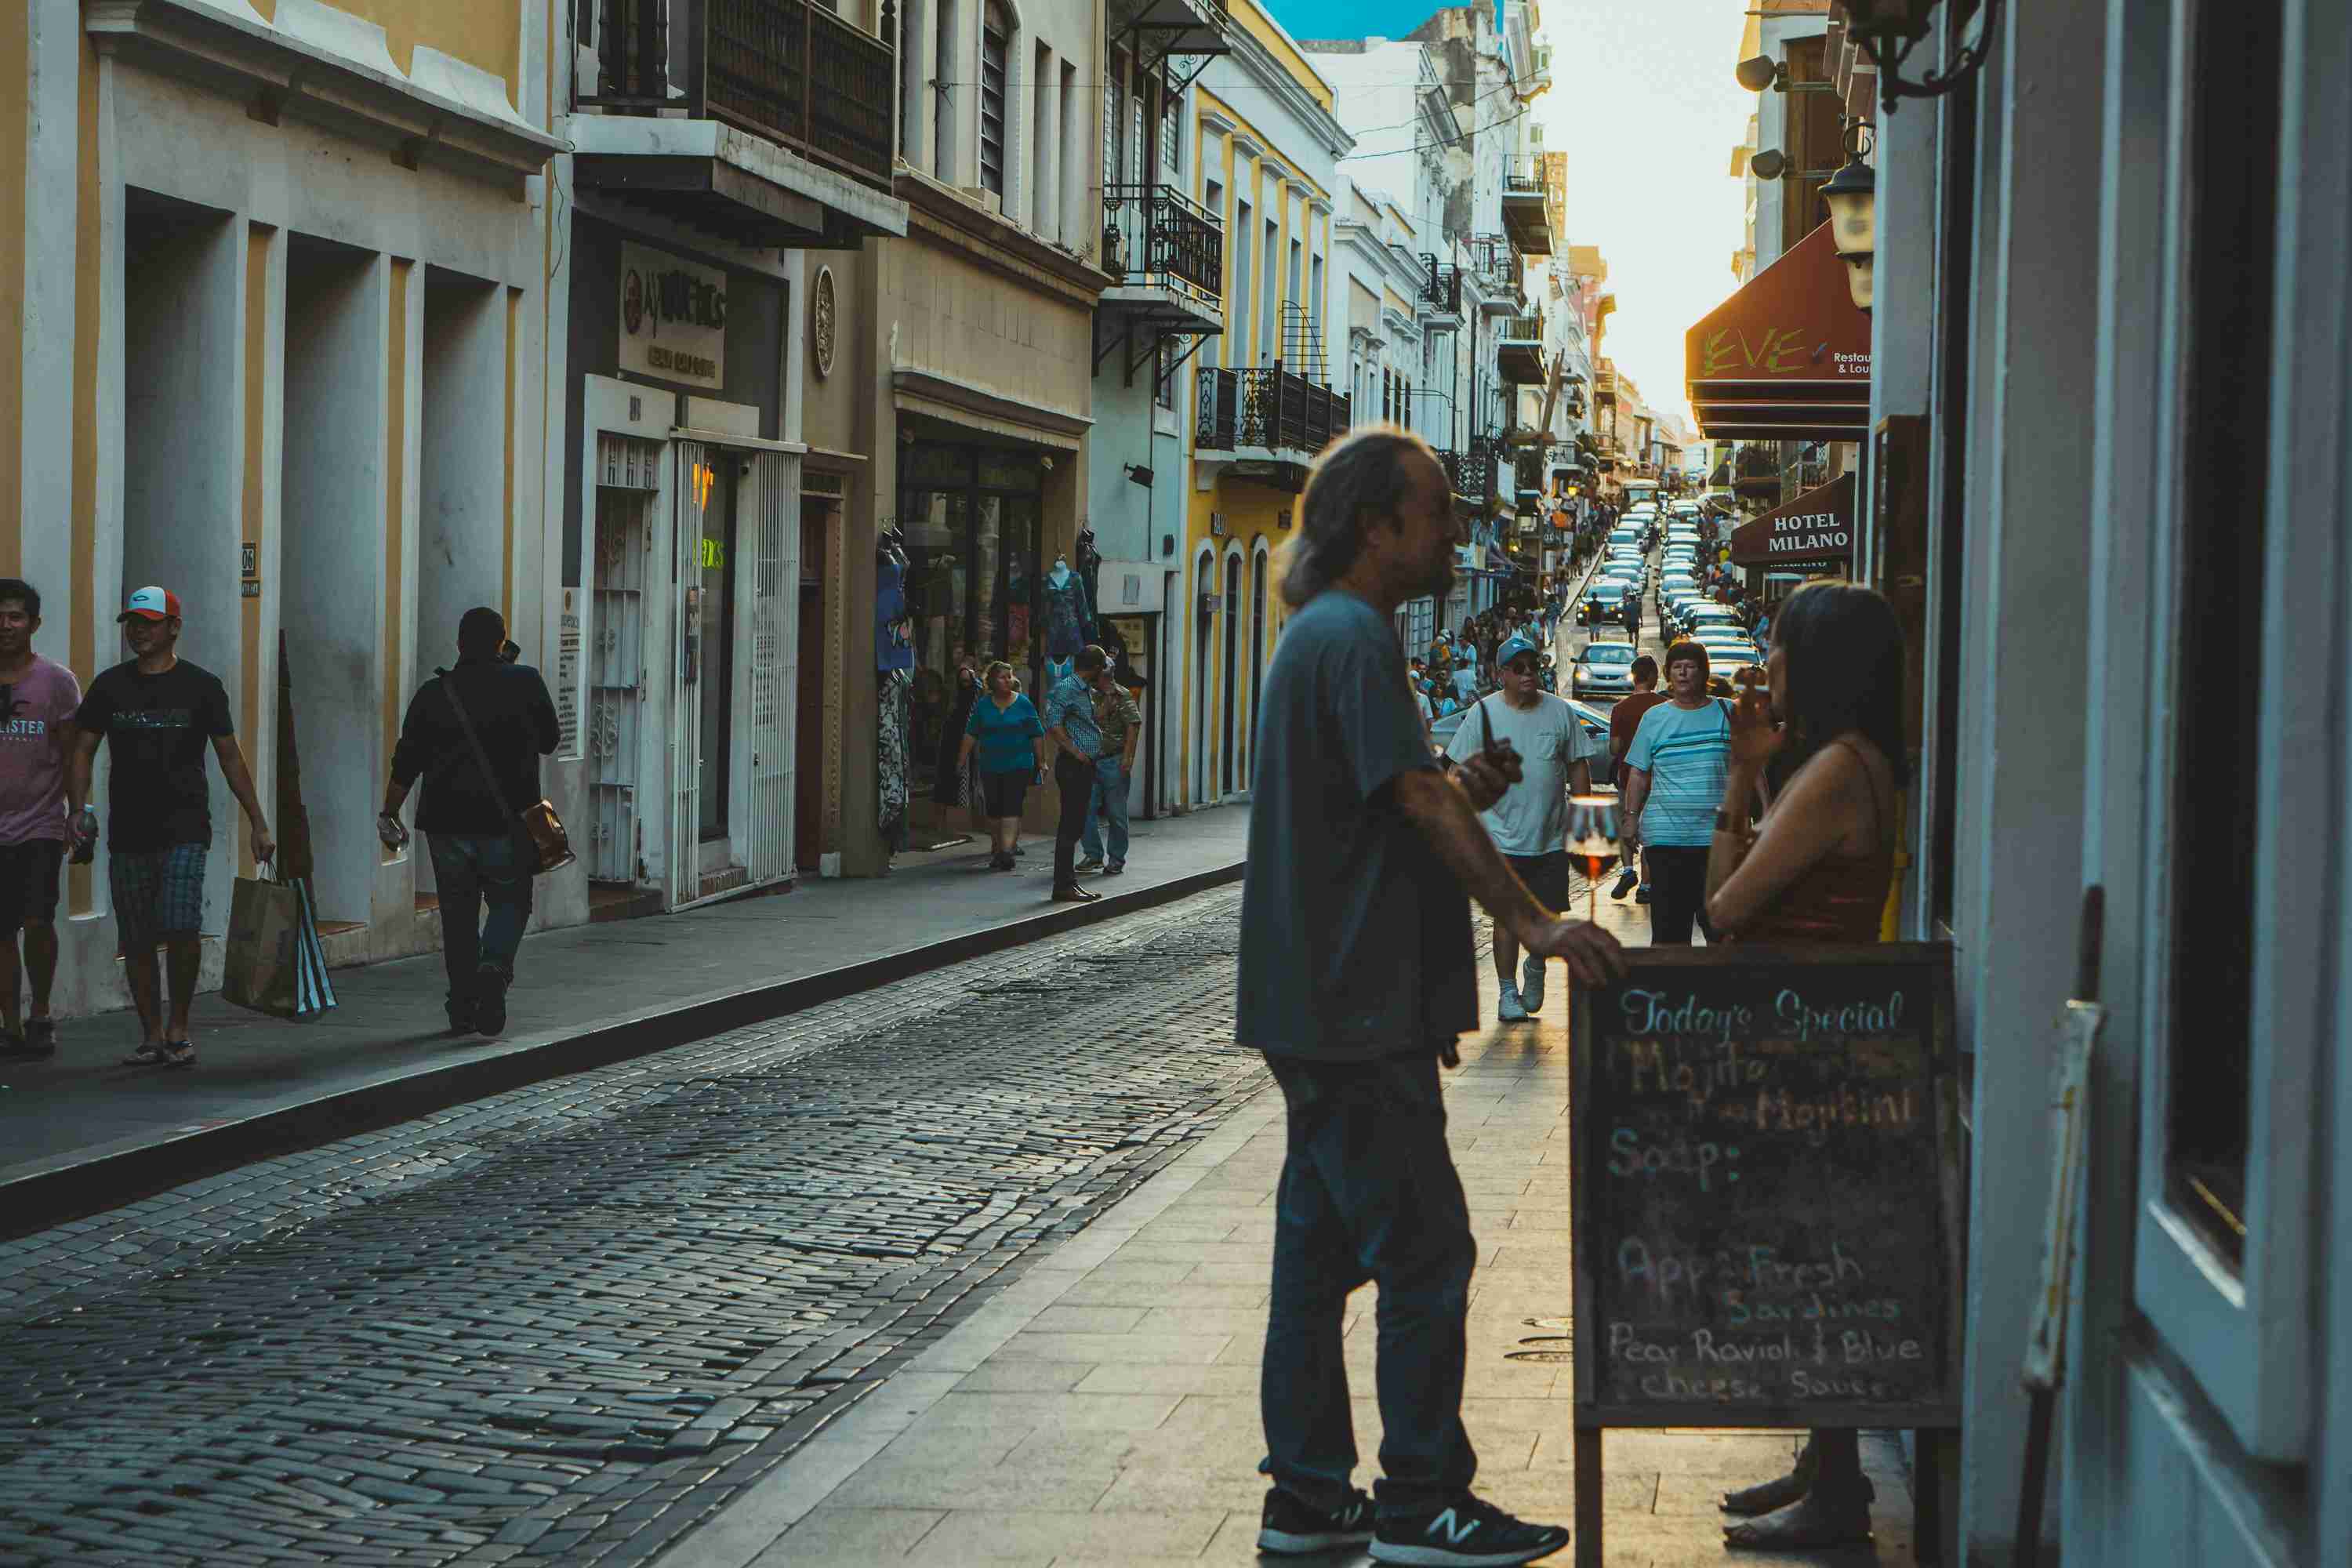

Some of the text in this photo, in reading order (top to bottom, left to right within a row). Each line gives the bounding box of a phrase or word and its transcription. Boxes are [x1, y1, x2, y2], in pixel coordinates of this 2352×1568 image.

[1704, 328, 1806, 376] EVE
[1838, 365, 1846, 374] &
[1775, 513, 1841, 532] HOTEL
[1769, 532, 1849, 553] MILANO
[1619, 987, 1906, 1047] Today's Special
[1609, 1322, 1678, 1362] Pear
[1841, 1330, 1922, 1363] Blue
